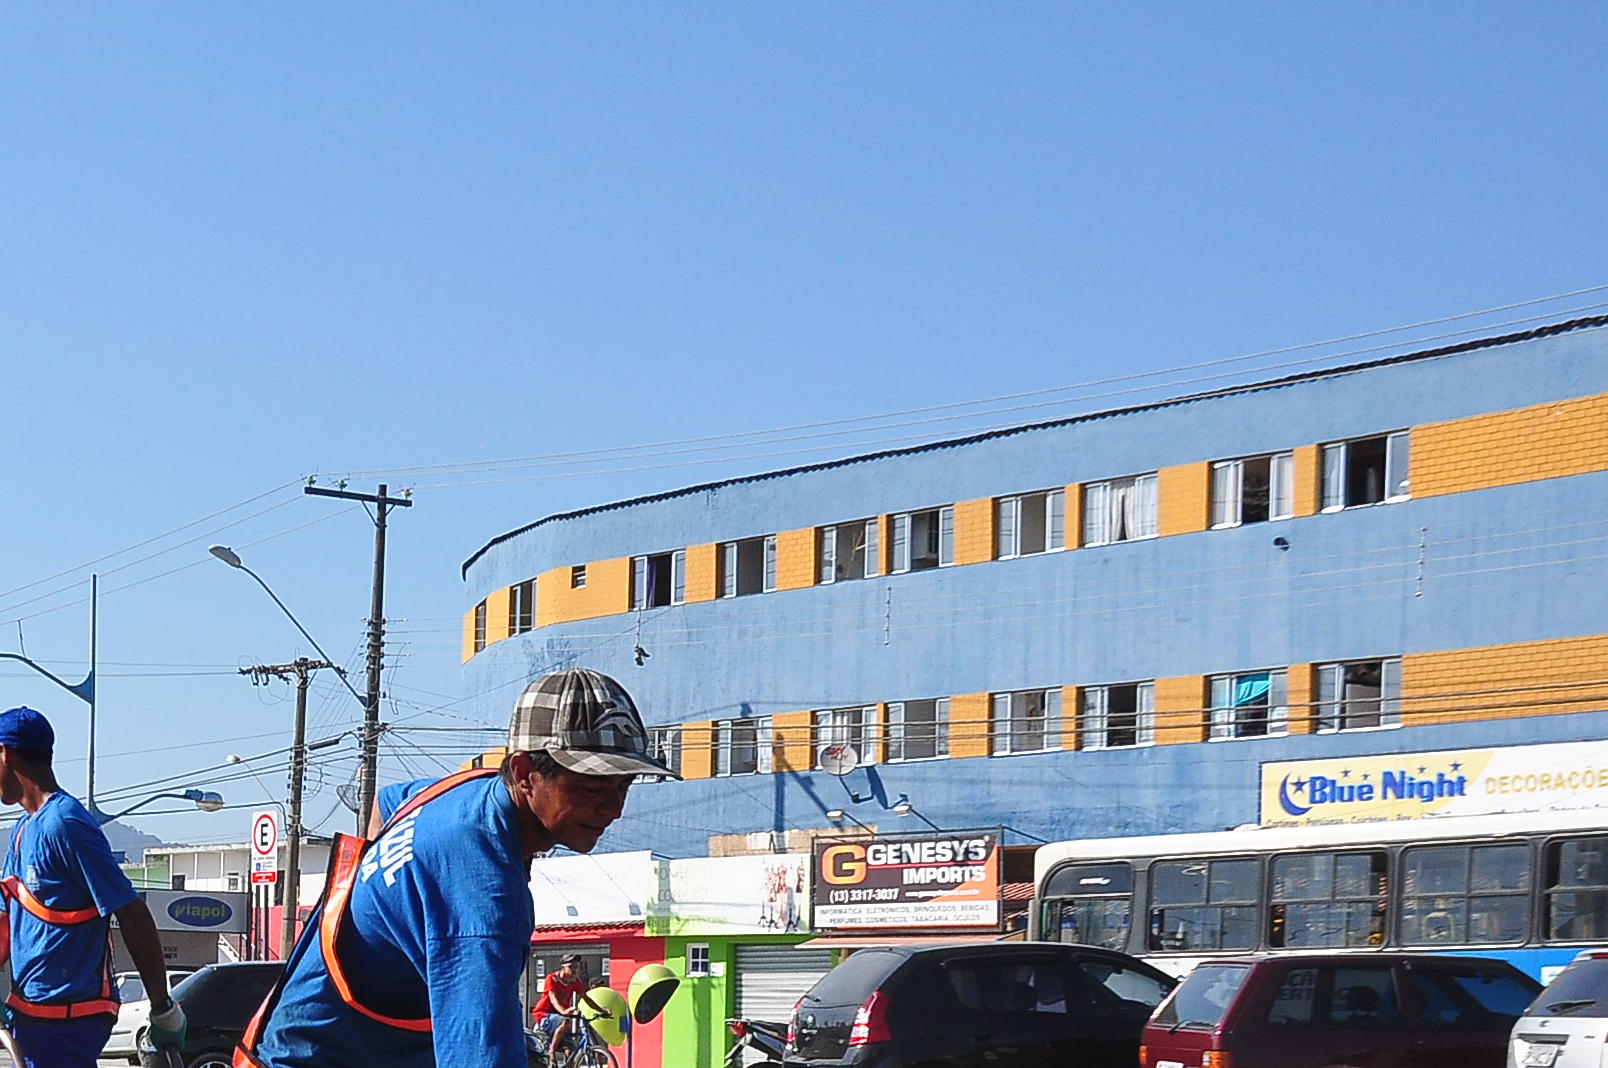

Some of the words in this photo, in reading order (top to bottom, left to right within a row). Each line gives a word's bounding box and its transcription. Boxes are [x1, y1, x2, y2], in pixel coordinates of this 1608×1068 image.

[1309, 775, 1375, 805] Blue
[1381, 769, 1469, 803] Night
[260, 823, 269, 847] E
[821, 844, 868, 885] G
[866, 839, 987, 866] GENESYS
[902, 866, 987, 885] IMPORTS
[829, 889, 849, 904] (13)
[850, 888, 900, 901] 3317-3037
